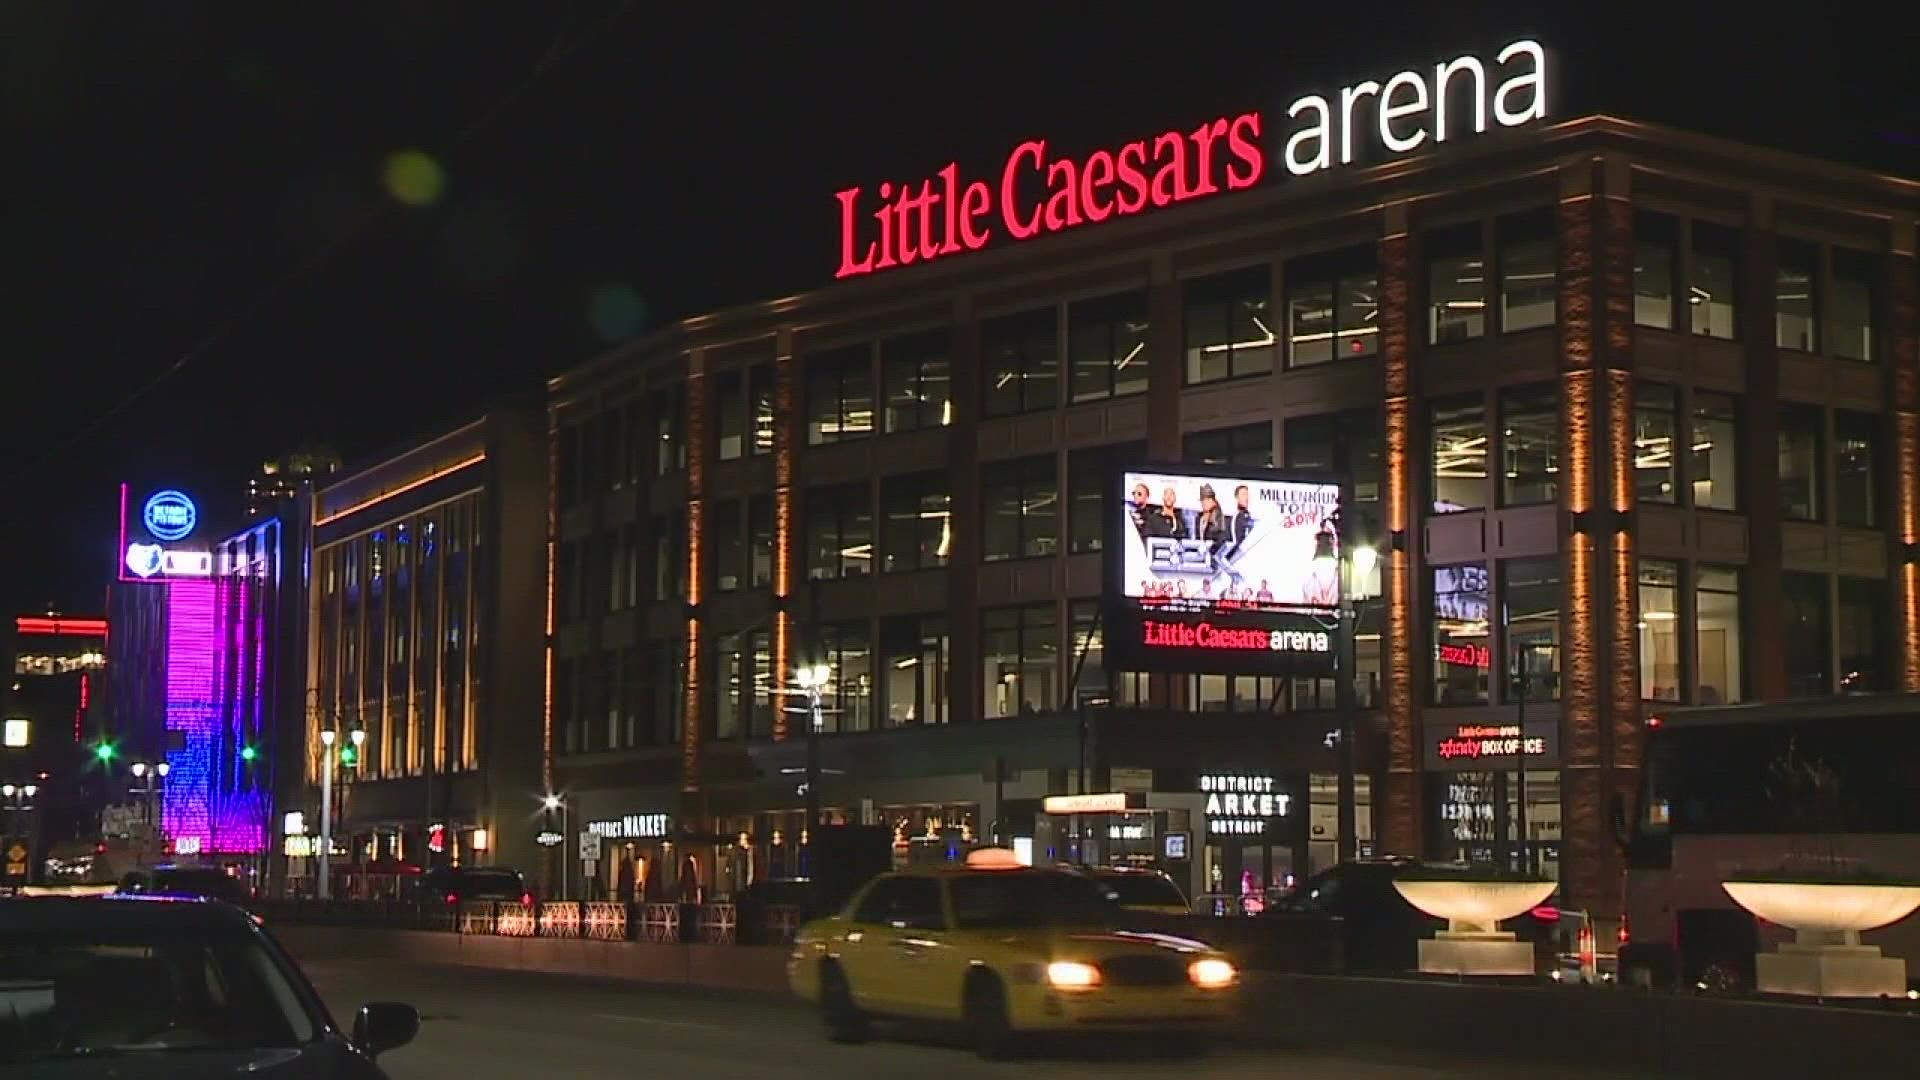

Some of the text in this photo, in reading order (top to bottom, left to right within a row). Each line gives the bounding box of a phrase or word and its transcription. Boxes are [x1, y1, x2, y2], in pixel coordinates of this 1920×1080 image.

[834, 38, 1548, 279] Little Caesars arena
[1144, 620, 1328, 652] Little Caesars arena
[1481, 739, 1503, 755] BOX
[1504, 739, 1543, 755] OFICE
[1200, 775, 1273, 793] DISTRICT
[623, 814, 668, 838] MARKET
[1211, 819, 1264, 835] DETROIT
